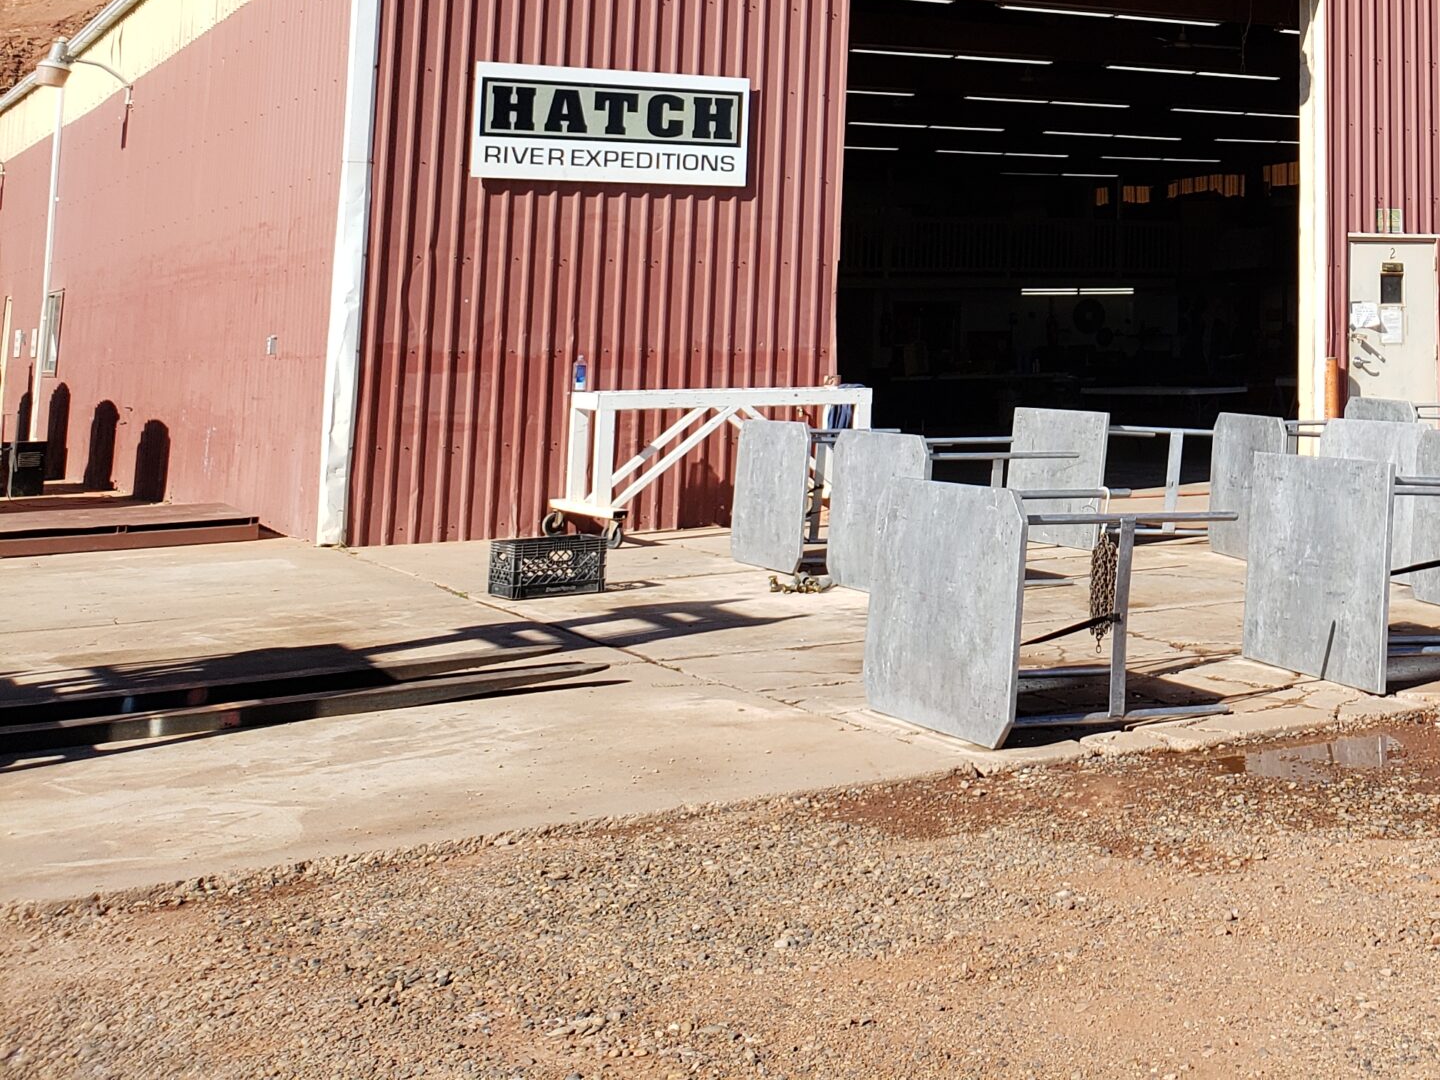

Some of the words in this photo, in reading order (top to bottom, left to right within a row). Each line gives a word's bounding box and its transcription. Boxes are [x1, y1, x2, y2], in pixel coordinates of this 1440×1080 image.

[490, 85, 734, 139] HATCH
[484, 145, 564, 166] RIVER
[570, 148, 736, 172] EXPEDITIONS
[1389, 247, 1396, 260] 2
